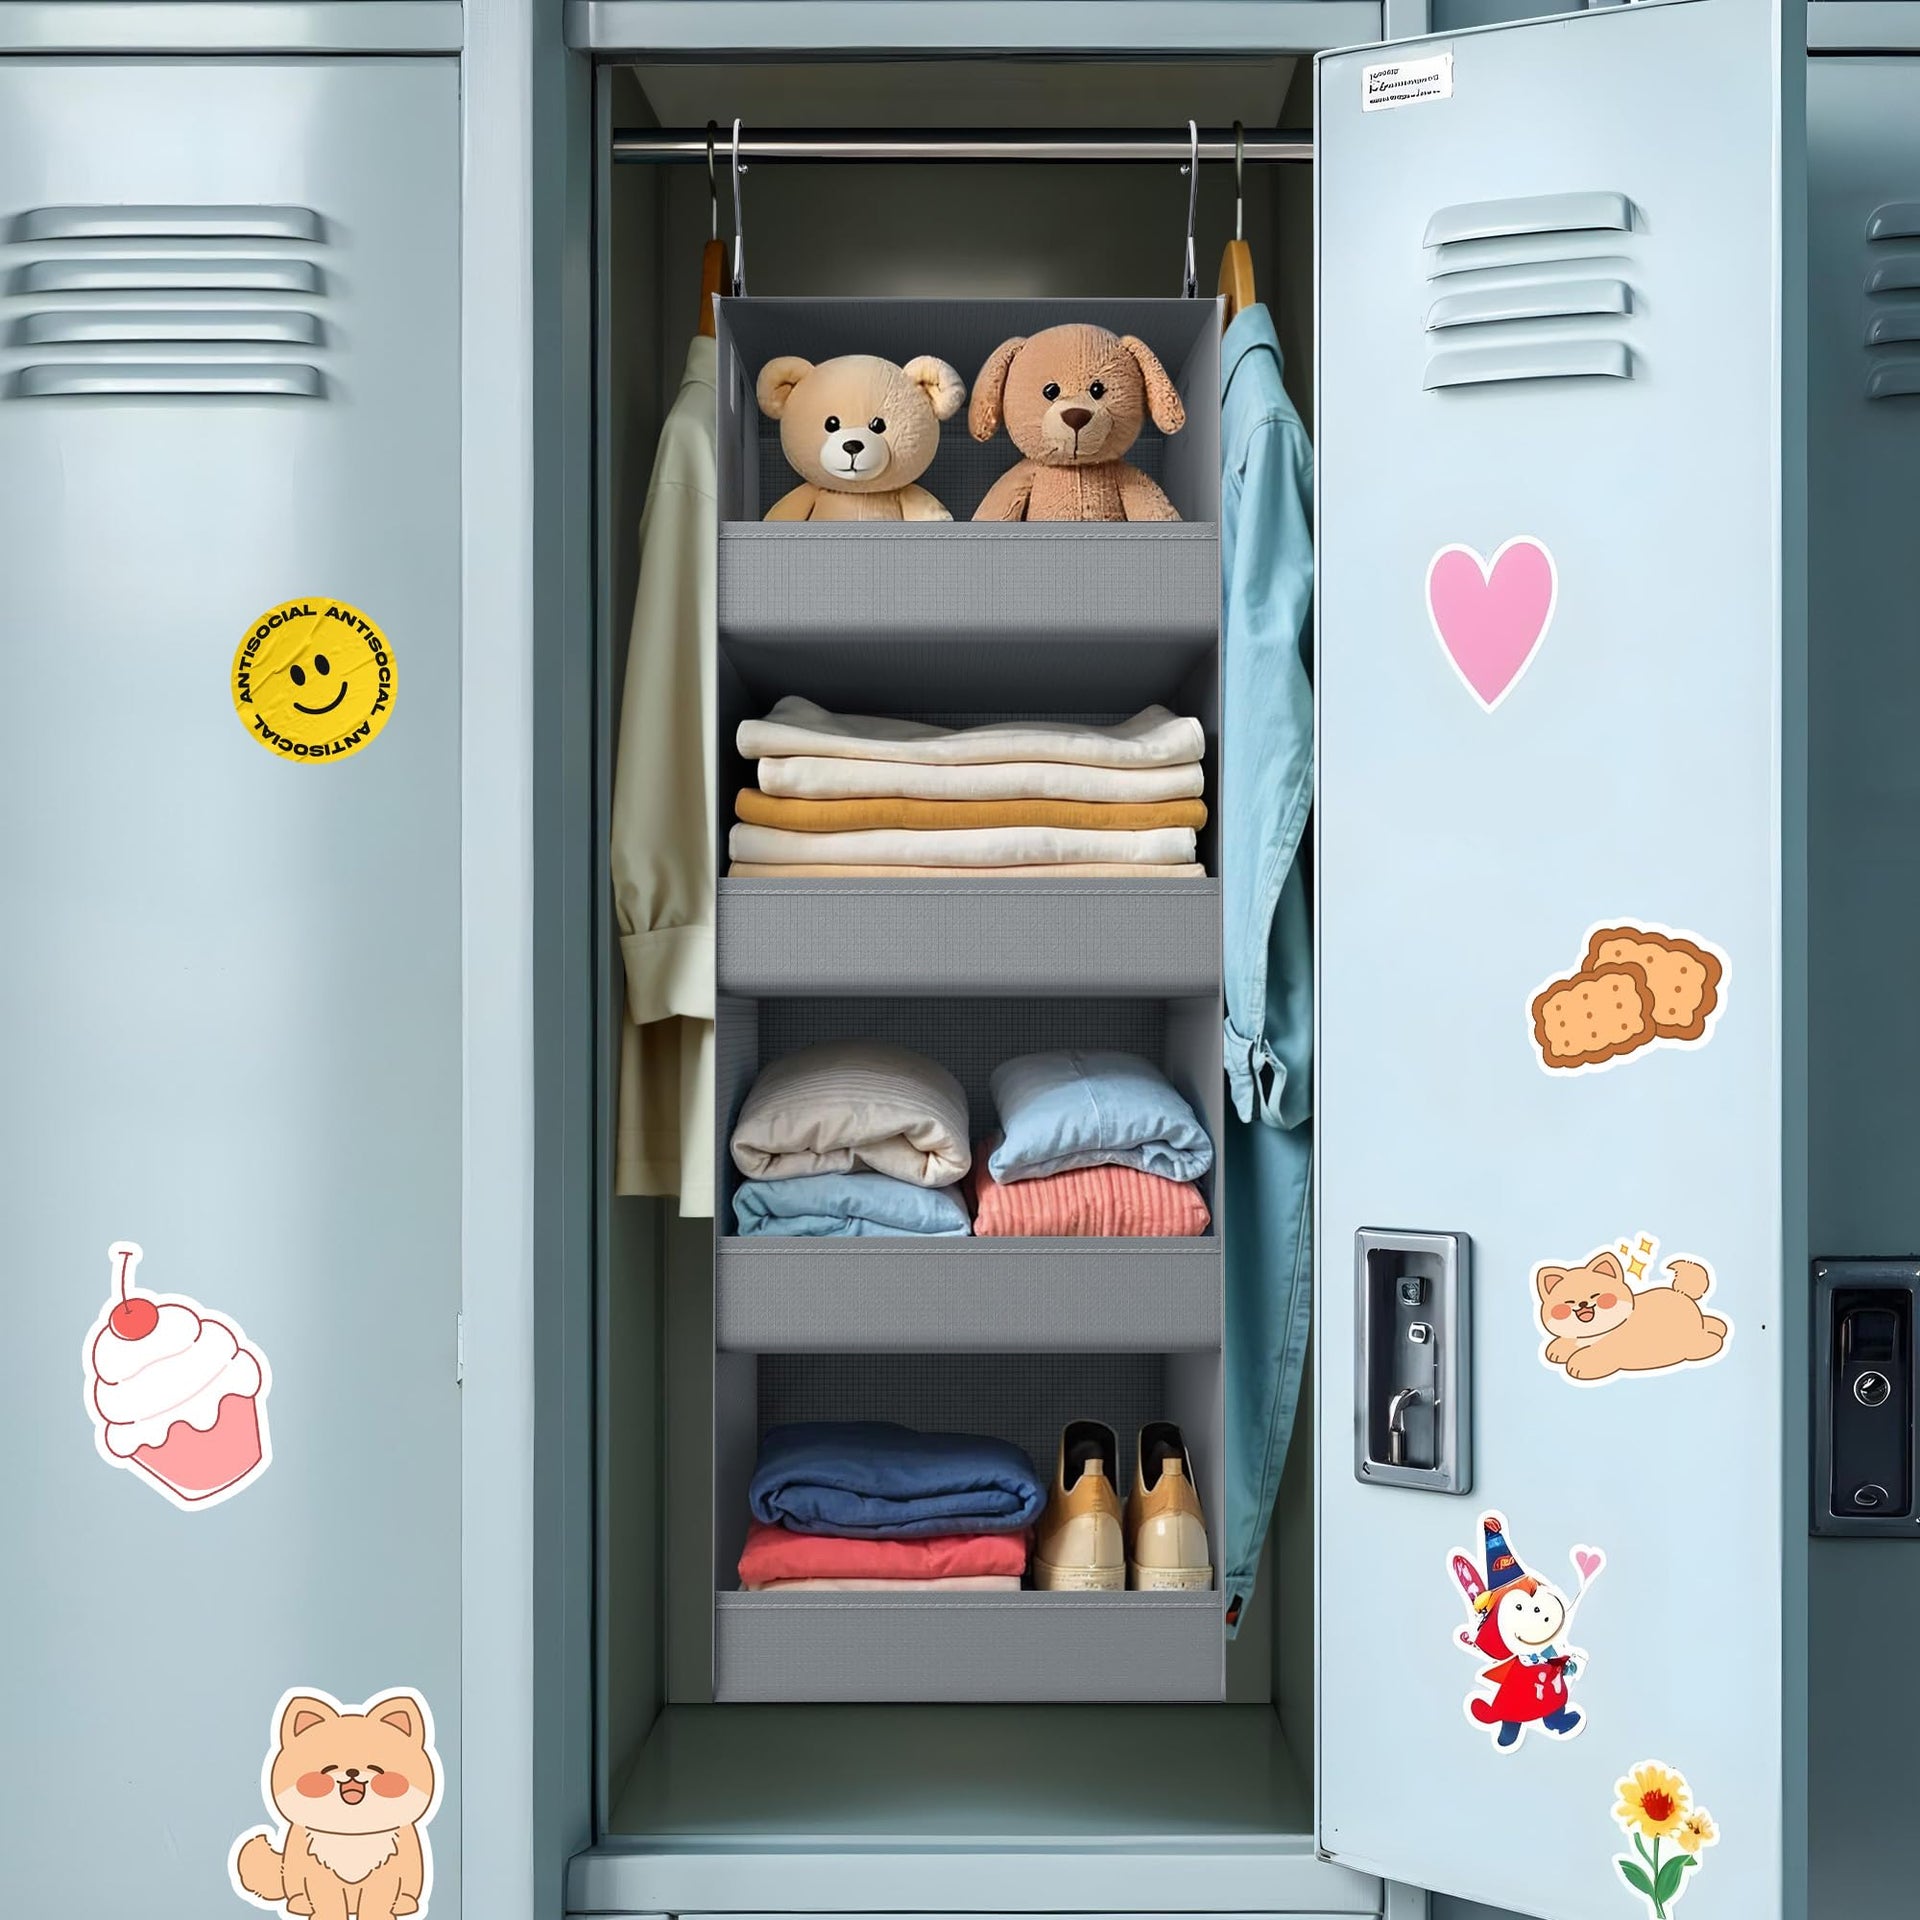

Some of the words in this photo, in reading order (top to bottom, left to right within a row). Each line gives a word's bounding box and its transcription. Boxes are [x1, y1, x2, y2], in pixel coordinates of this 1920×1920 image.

[238, 605, 317, 704] ANTISOCIAL
[325, 607, 391, 716] ANTISOCIAL
[254, 714, 371, 757] ANTISOCIAL
